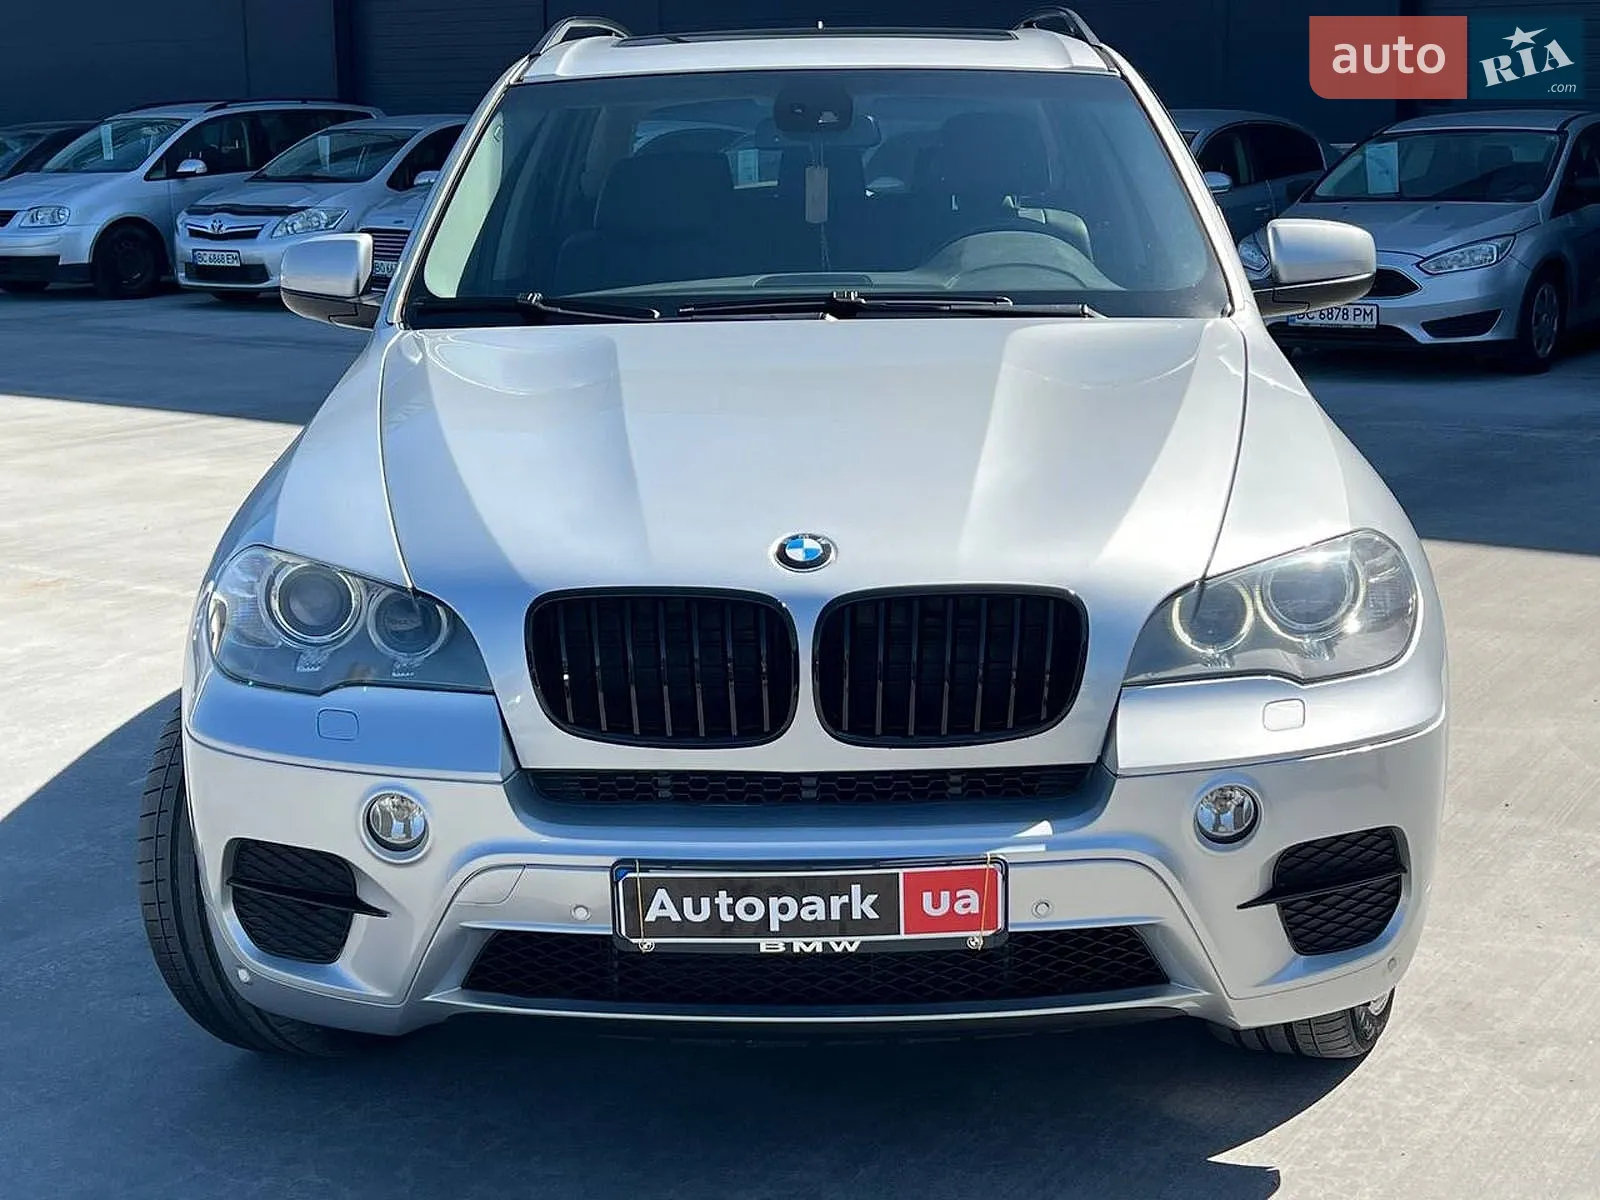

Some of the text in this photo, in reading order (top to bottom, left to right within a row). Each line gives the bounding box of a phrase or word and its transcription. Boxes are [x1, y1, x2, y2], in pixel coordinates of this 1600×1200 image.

[1319, 307, 1350, 321] 6878
[1353, 308, 1374, 322] PM
[644, 884, 980, 932] Autopark ua
[759, 940, 863, 953] BMW
